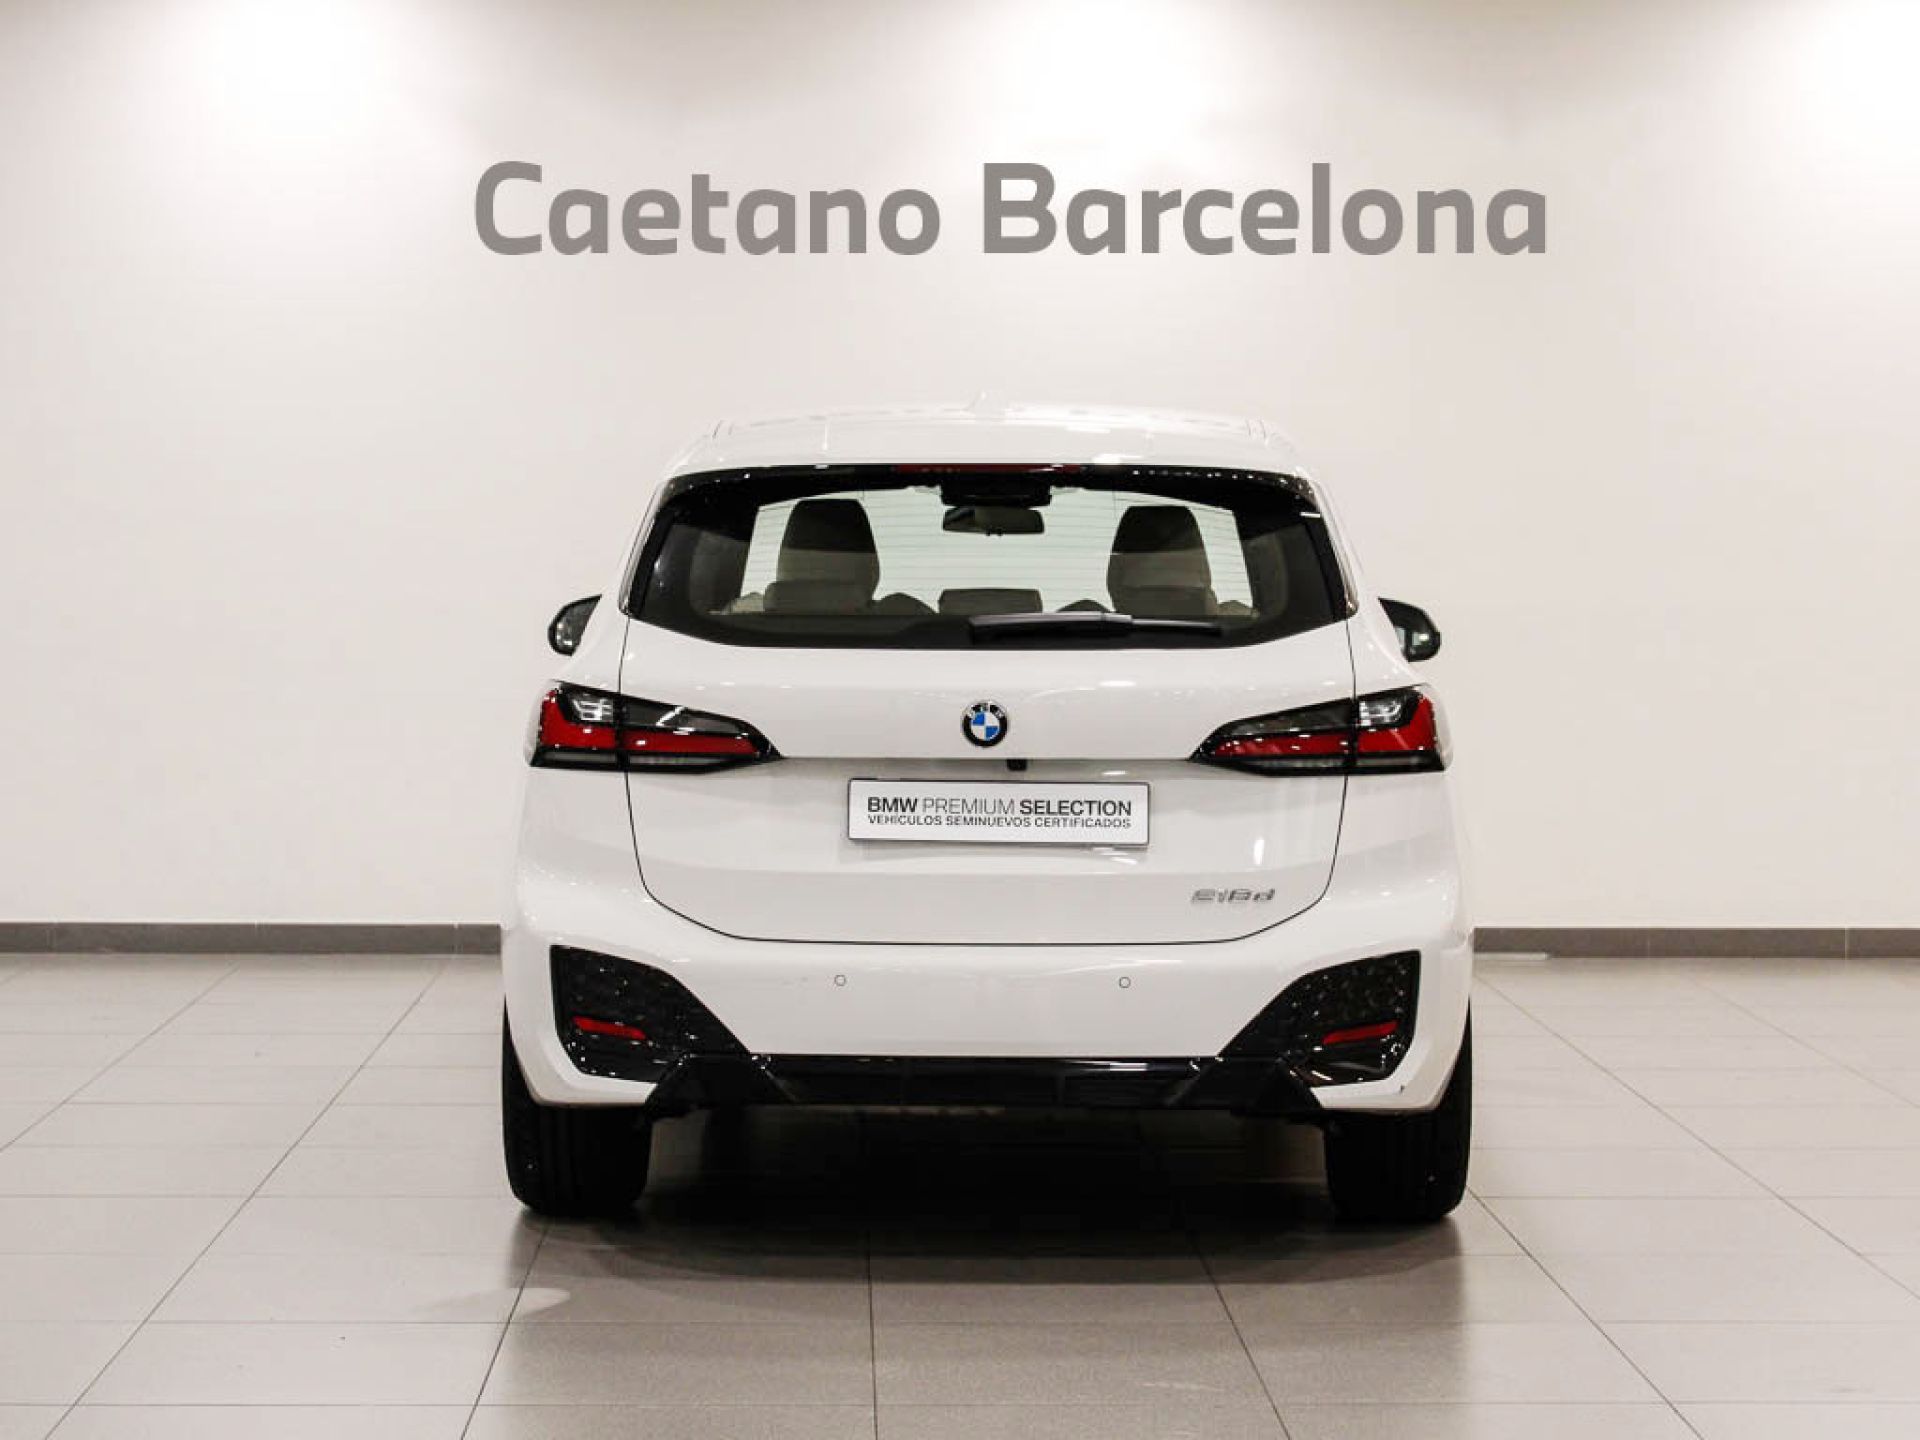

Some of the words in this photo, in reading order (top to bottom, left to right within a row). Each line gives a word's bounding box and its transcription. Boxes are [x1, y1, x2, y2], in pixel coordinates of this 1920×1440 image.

[867, 797, 917, 812] BMW
[922, 799, 1014, 814] PREMIUM
[1020, 800, 1132, 816] SELECTION
[946, 816, 1032, 828] SEMINUEVOS
[1034, 817, 1132, 829] CERTIFICADOS
